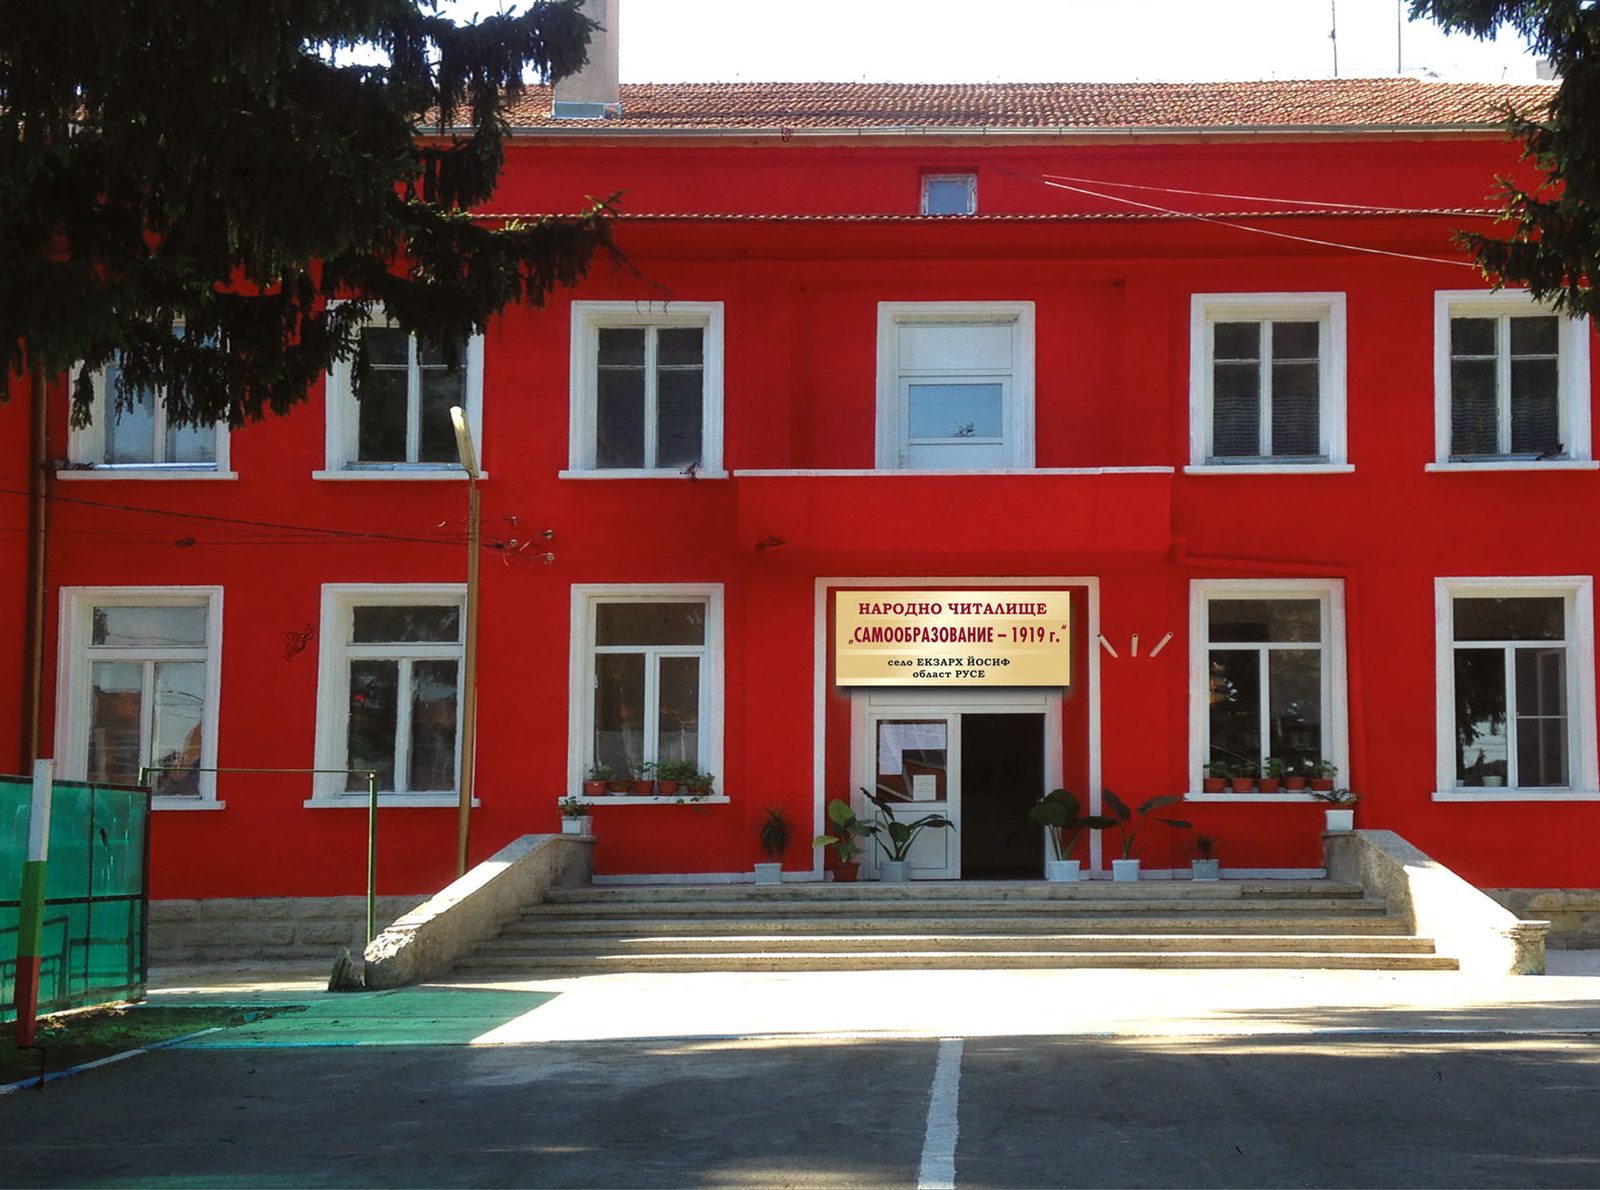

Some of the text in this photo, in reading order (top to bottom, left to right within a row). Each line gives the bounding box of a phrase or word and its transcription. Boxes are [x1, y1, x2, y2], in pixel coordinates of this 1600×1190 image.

[858, 603, 1047, 616] НАРОДНО ЧИТАЛИЩЕ
[1011, 626, 1045, 643] 1919
[887, 656, 1011, 667] село ЕКЗАРХ ЙОСИФ
[912, 670, 986, 678] област РУСЕ
